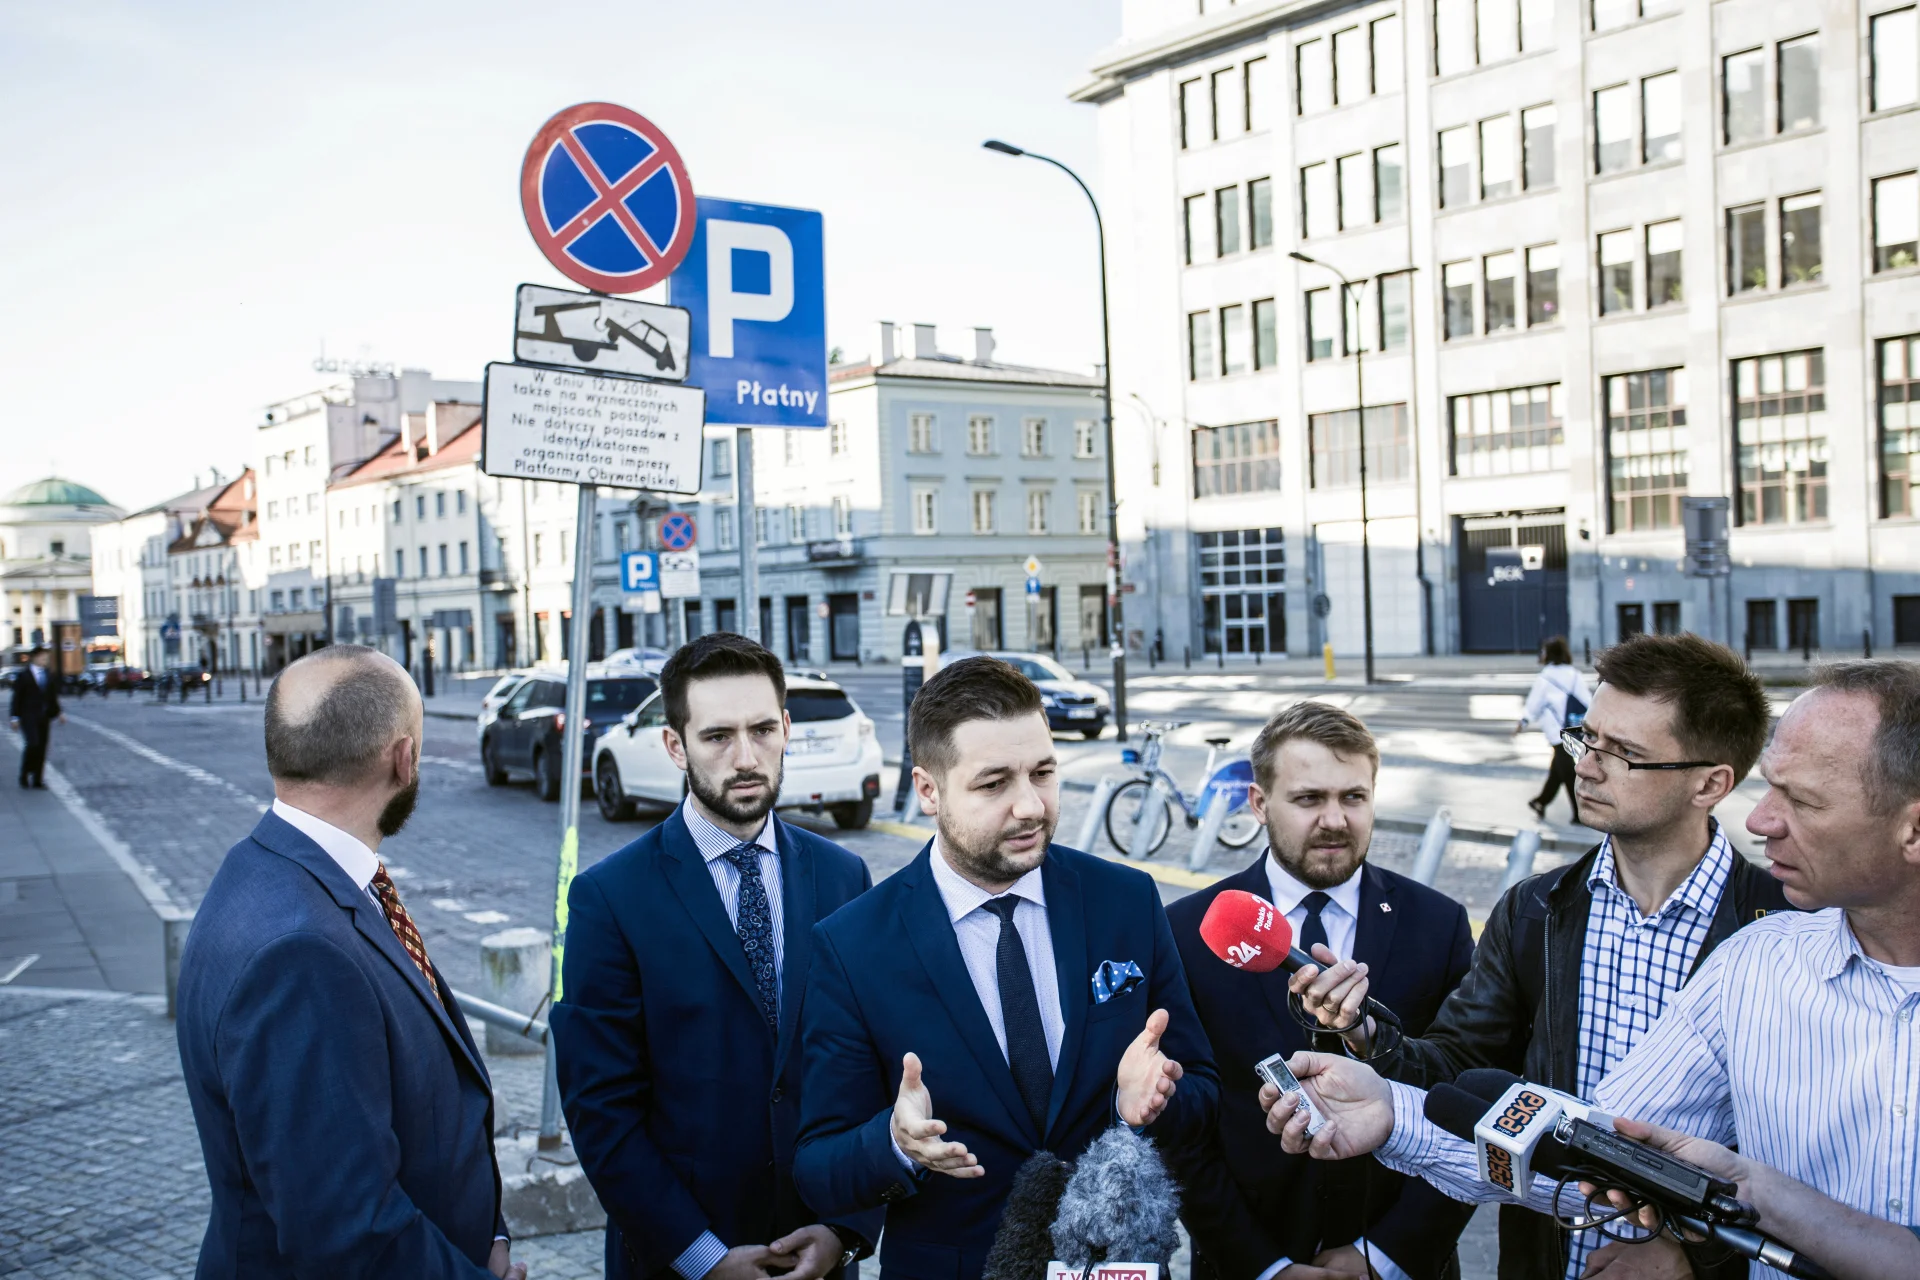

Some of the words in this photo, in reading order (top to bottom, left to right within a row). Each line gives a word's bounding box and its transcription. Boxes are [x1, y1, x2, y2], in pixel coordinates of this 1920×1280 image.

[706, 218, 795, 358] P
[533, 371, 545, 383] W
[554, 375, 584, 389] dniu
[533, 402, 602, 418] miejscach
[560, 390, 577, 400] na
[586, 393, 678, 413] wyznaczonych
[736, 380, 819, 414] Płatny
[512, 412, 535, 427] Nie
[544, 416, 596, 436] dotyczy
[673, 432, 680, 442] z
[543, 432, 650, 454] identyfikatorem
[514, 460, 579, 479] Platformy
[523, 448, 612, 465] organizatora
[620, 454, 670, 474] imprezy
[627, 554, 652, 589] P
[1496, 1090, 1547, 1135] eska
[1486, 1143, 1513, 1189] eska
